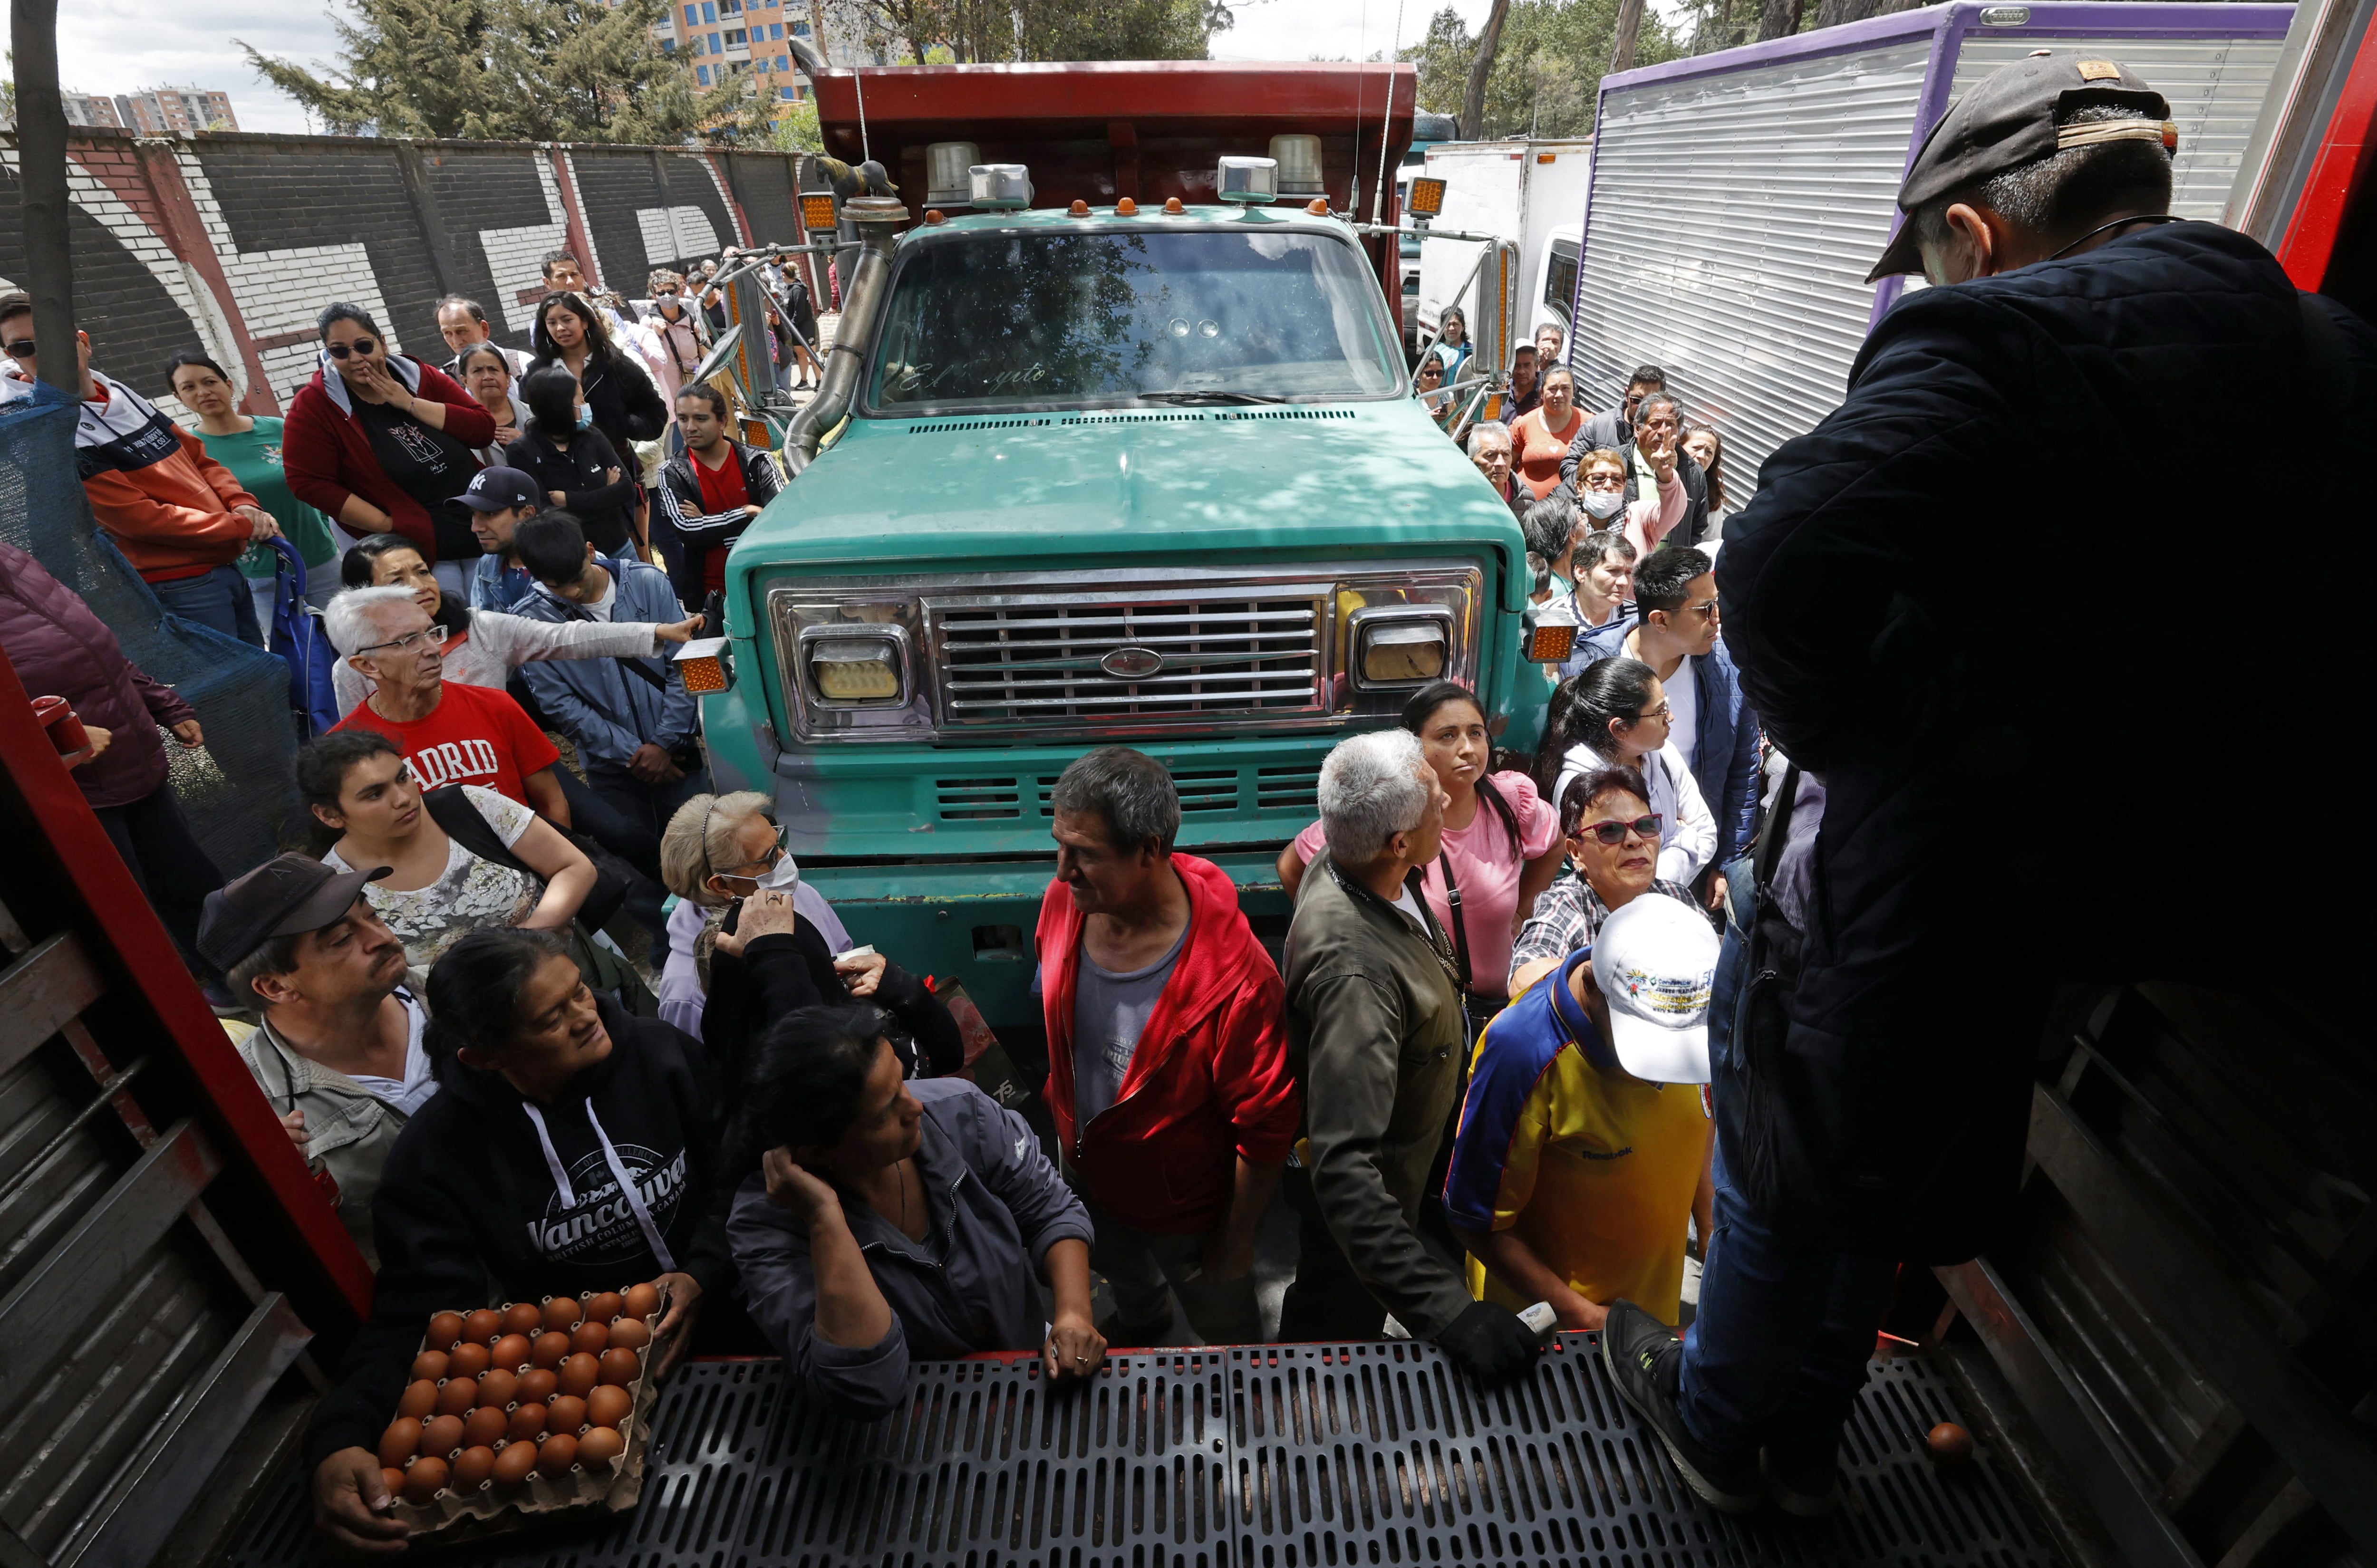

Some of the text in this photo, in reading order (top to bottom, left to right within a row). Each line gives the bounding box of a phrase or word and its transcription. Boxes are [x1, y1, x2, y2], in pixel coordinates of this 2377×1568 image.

[402, 739, 498, 792] ADRID
[992, 1078, 1014, 1104] 75
[1582, 1146, 1633, 1161] Reebok
[525, 1146, 686, 1254] Vancouver
[546, 1237, 595, 1262] BRITISH
